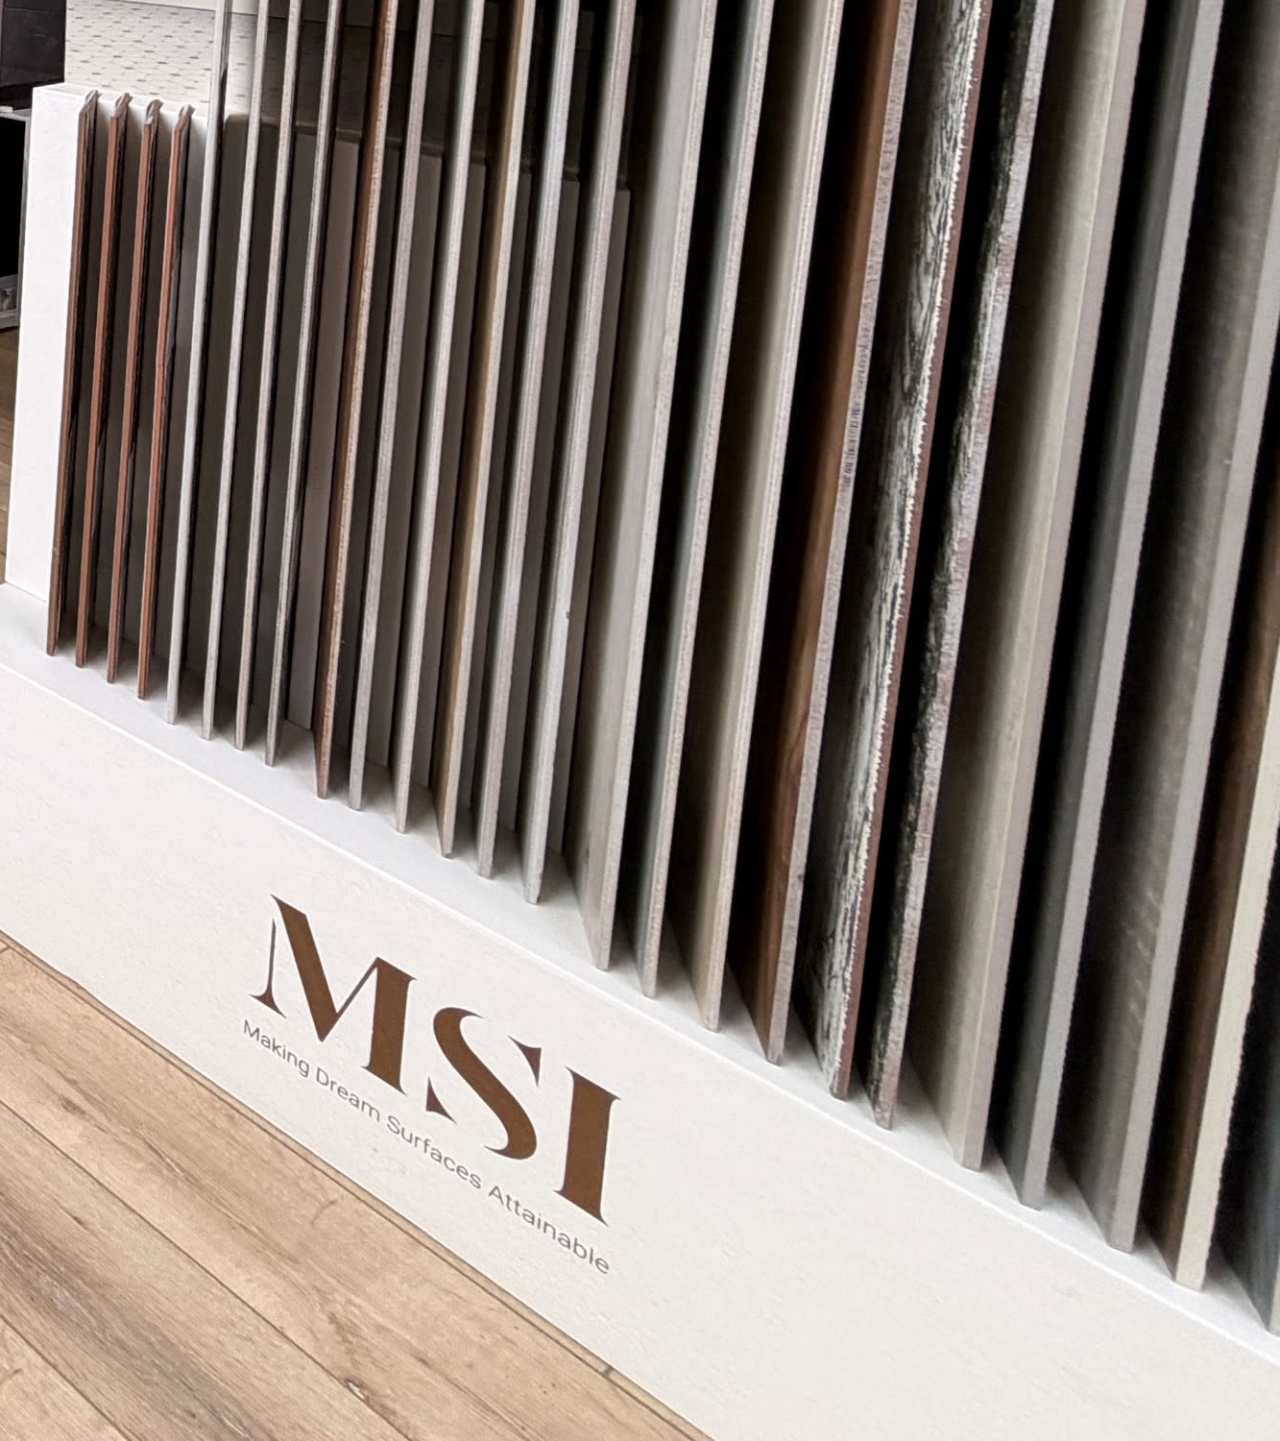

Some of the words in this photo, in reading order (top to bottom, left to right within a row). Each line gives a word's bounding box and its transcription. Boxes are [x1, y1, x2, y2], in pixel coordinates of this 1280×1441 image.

[243, 1018, 310, 1079] Making
[315, 1066, 381, 1125] Dream
[386, 1114, 482, 1191] Surfaces
[487, 1183, 611, 1276] Attainable
[248, 894, 622, 1227] MSI
